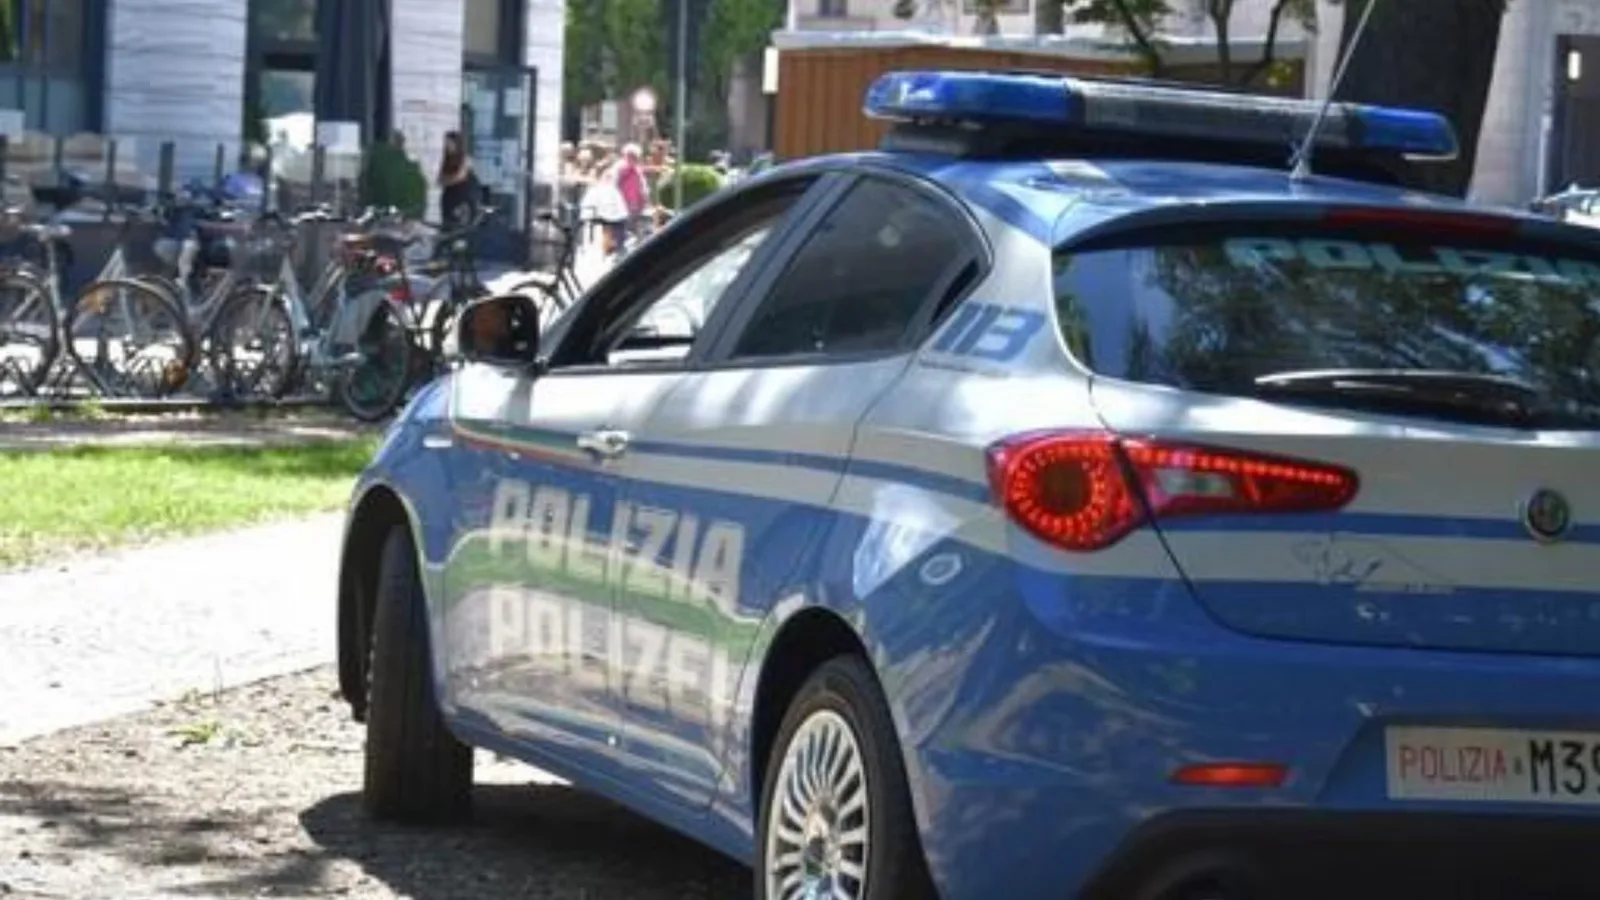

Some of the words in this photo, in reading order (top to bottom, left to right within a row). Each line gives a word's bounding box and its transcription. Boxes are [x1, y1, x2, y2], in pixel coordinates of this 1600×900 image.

[932, 300, 1046, 362] 113
[490, 478, 745, 614] POLIZIA
[489, 585, 732, 726] POLIZEI
[1398, 745, 1507, 782] POLIZIA
